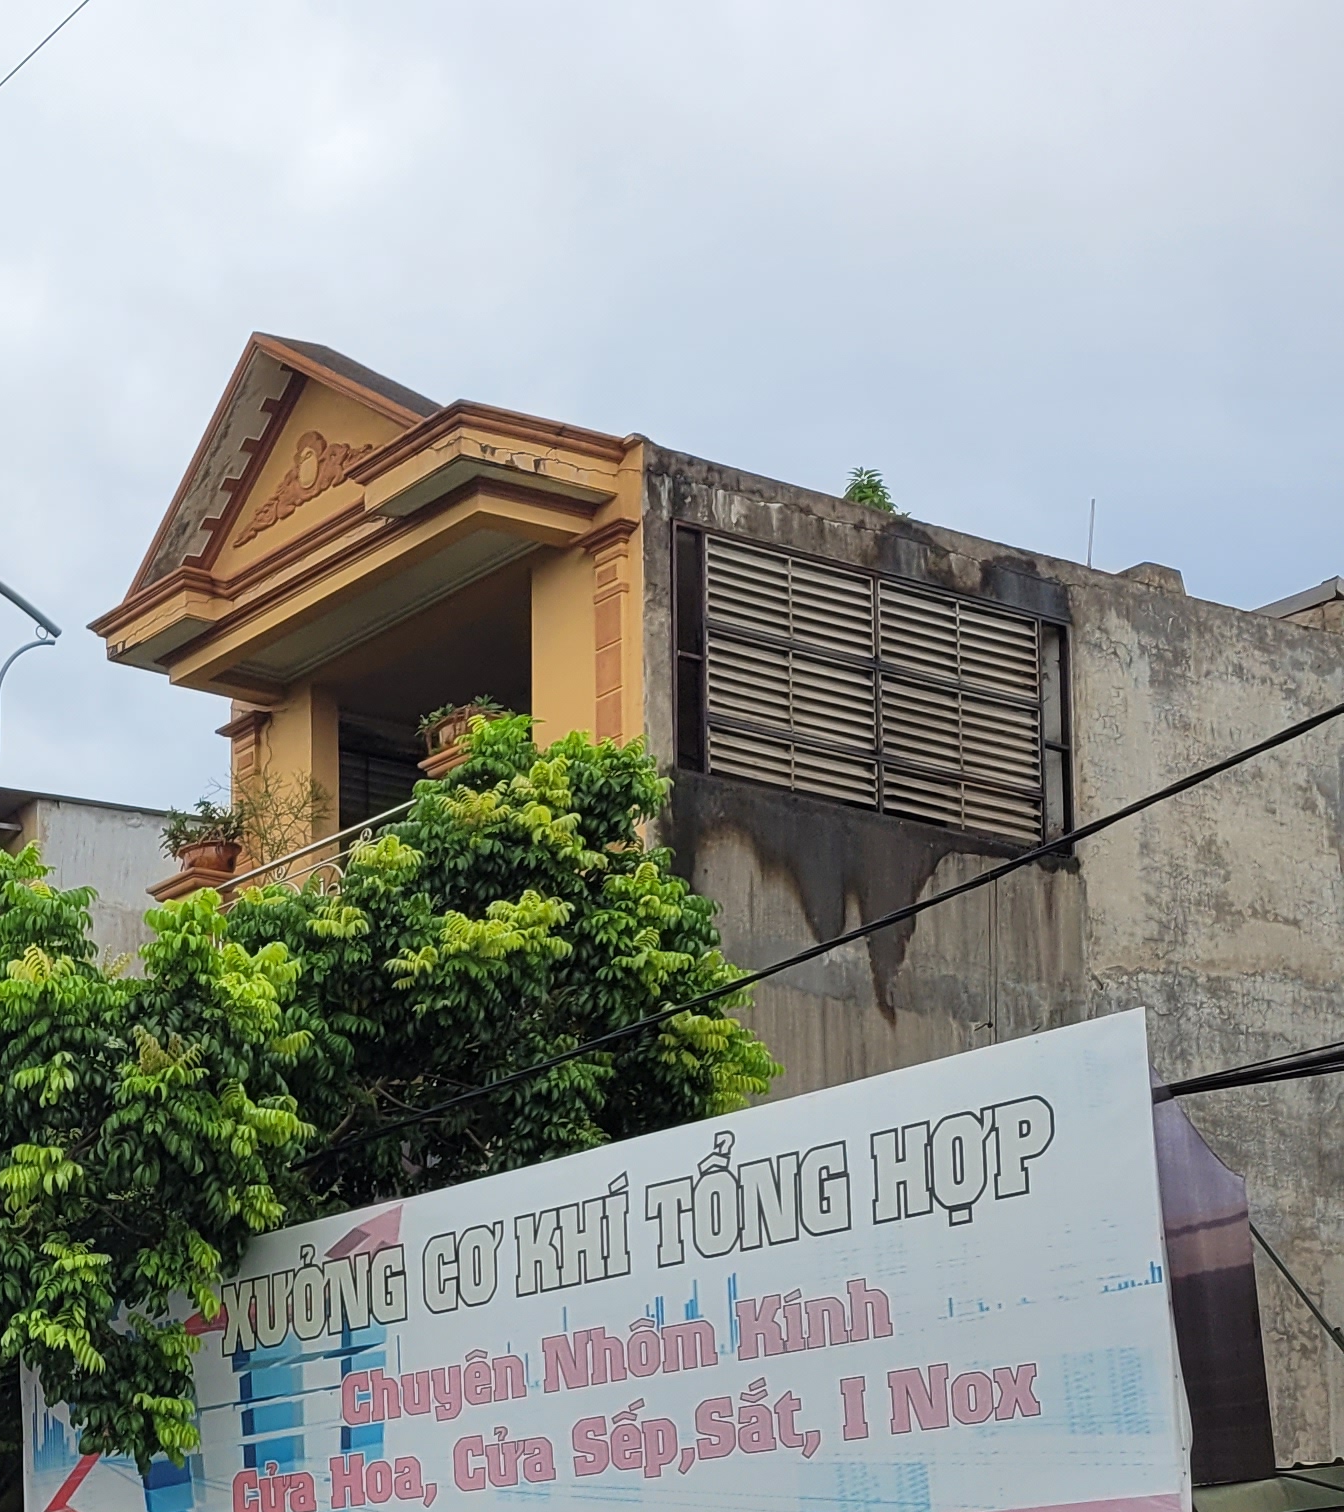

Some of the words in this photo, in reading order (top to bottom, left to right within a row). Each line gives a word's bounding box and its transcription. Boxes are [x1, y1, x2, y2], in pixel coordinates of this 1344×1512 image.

[222, 1244, 408, 1357] XƯỞNG
[422, 1220, 504, 1315] CƠ
[515, 1171, 631, 1297] KHÍ
[645, 1130, 852, 1268] TỔNG
[870, 1094, 1055, 1227] HỢP
[341, 1349, 528, 1426] Chuyên
[542, 1317, 718, 1394] Nhôm
[735, 1278, 893, 1361] Kính
[329, 1452, 438, 1508] Hoa,
[453, 1427, 557, 1493] Cửa
[840, 1376, 869, 1442] I
[887, 1362, 1042, 1436] Nox
